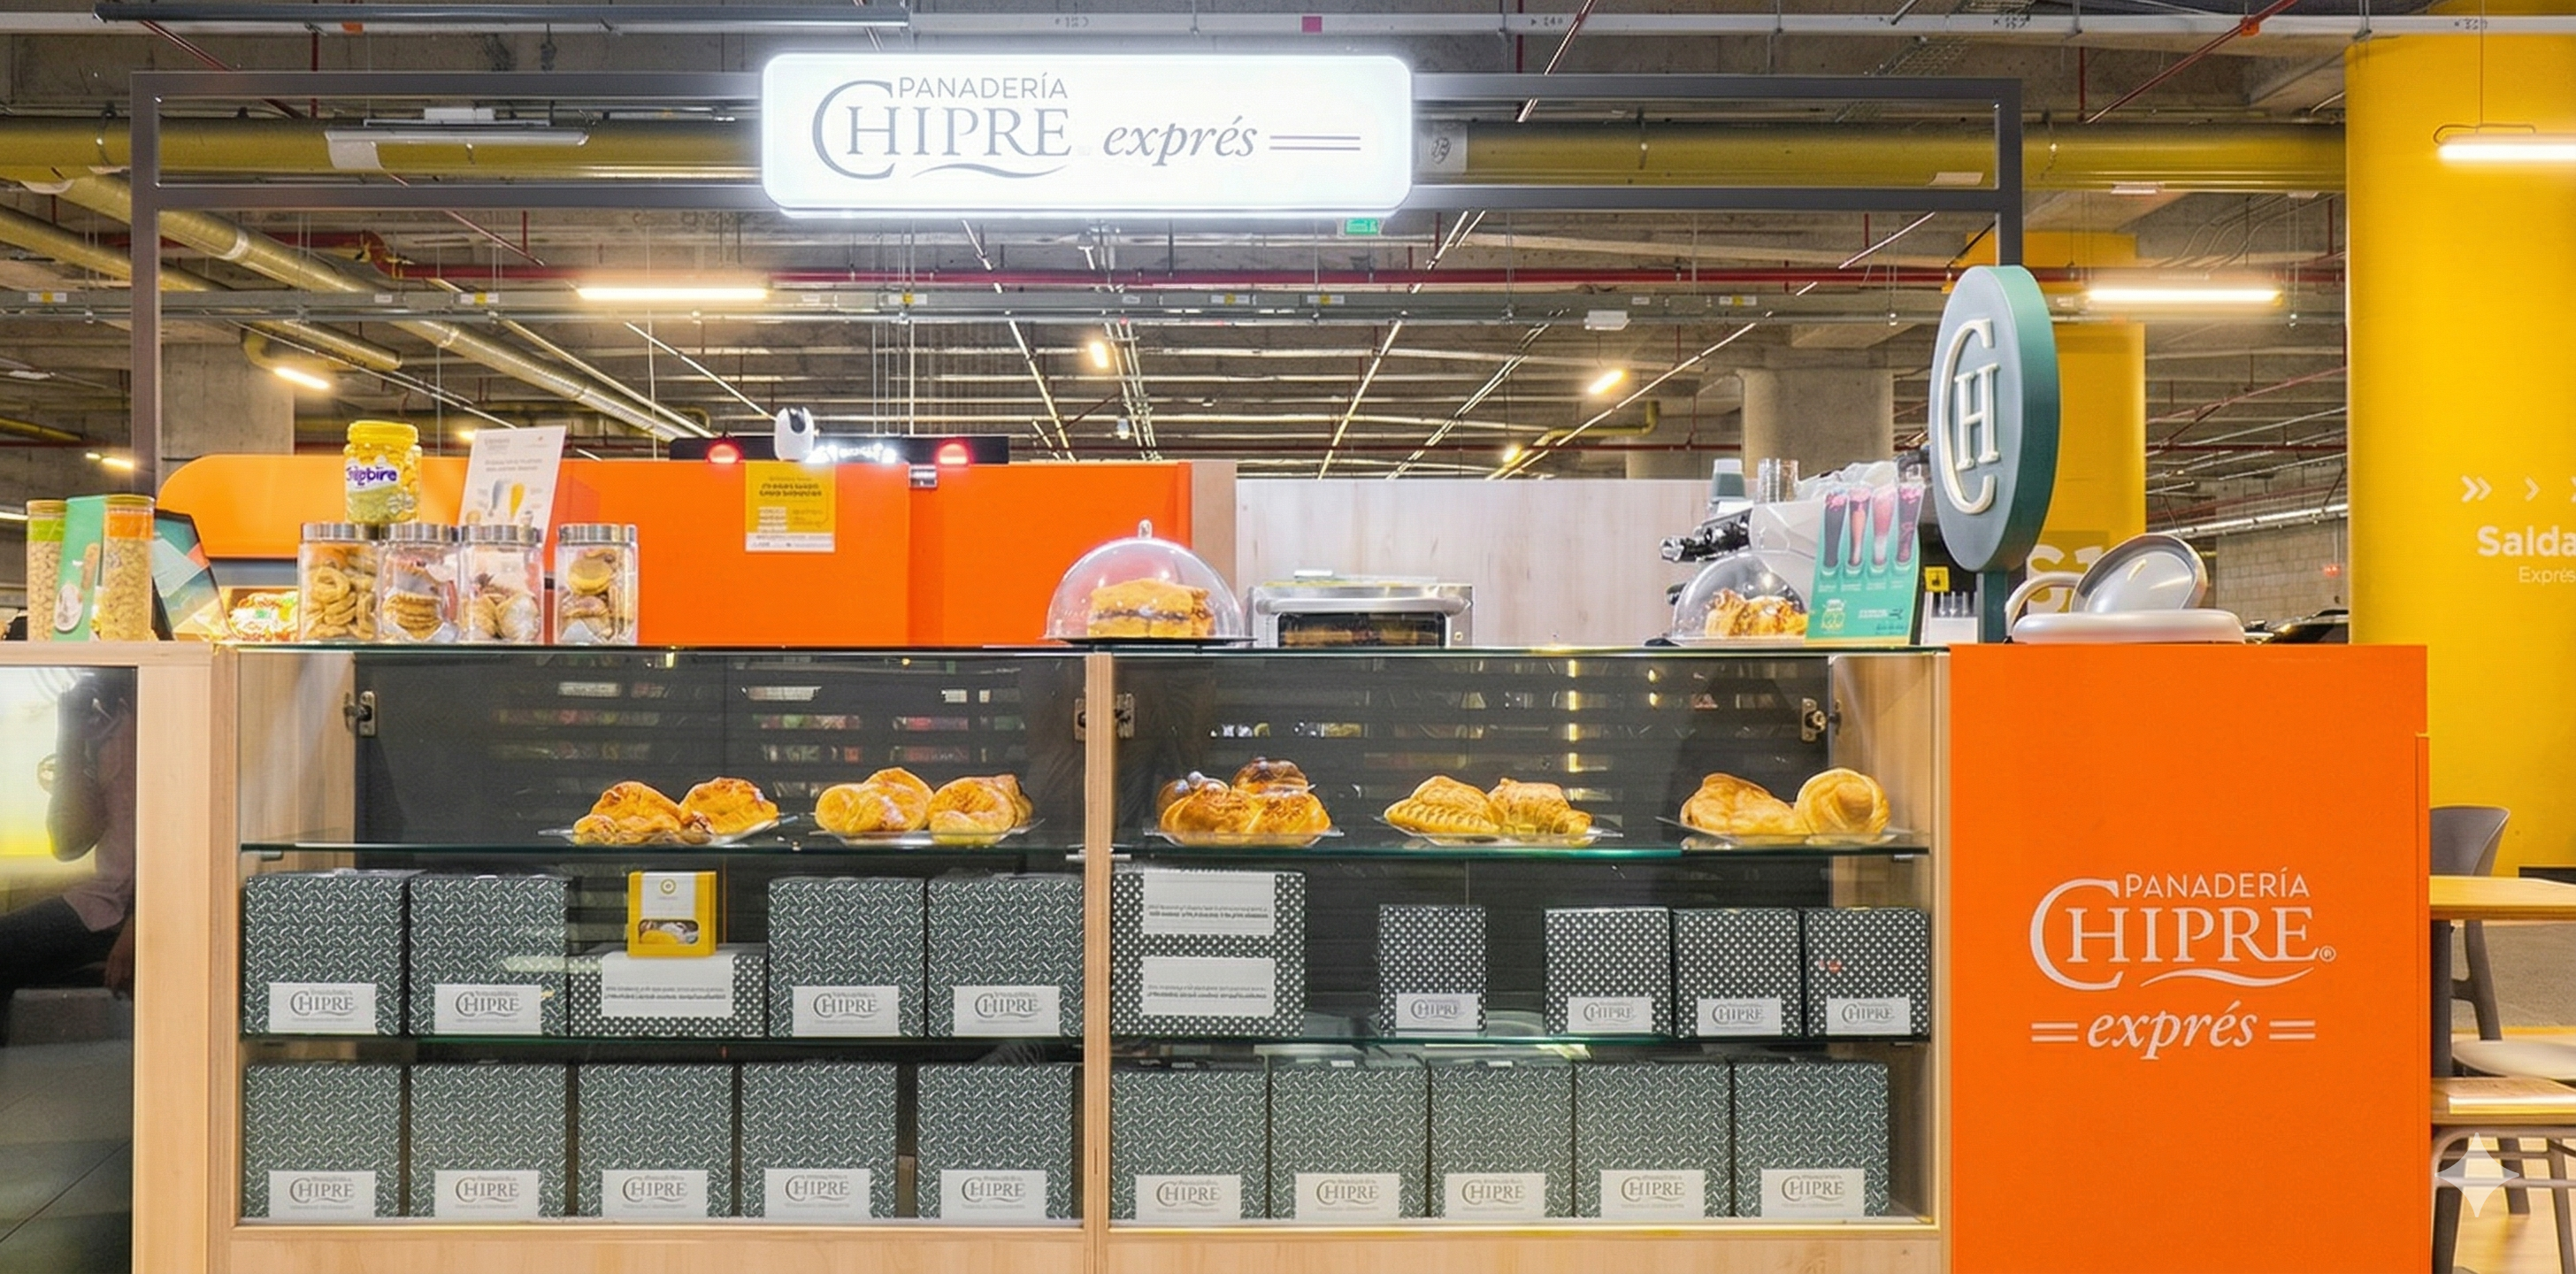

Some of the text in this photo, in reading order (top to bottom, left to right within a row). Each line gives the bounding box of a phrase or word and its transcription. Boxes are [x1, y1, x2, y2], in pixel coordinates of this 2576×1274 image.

[899, 72, 1069, 99] PANADERÍA
[811, 80, 1258, 180] CHIPRE exprés
[2125, 866, 2311, 899] PANADERÍA
[2029, 878, 2320, 991] CHIPRE
[290, 990, 354, 1017] CHIPRE
[456, 992, 521, 1017] CHIPRE
[813, 993, 879, 1017] CHIPRE
[975, 992, 1039, 1017] CHIPRE
[2087, 1000, 2258, 1061] exprés
[289, 1178, 354, 1204] CHIPRE
[456, 1177, 519, 1203] CHIPRE
[622, 1176, 688, 1203] CHIPRE
[786, 1175, 850, 1202] CHIPRE
[961, 1177, 1026, 1203] CHIPRE
[1156, 1181, 1222, 1207] CHIPRE
[1316, 1179, 1380, 1206] CHIPRE
[1461, 1179, 1525, 1205] CHIPRE
[1621, 1176, 1685, 1202] CHIPRE
[1782, 1176, 1845, 1202] CHIPRE
